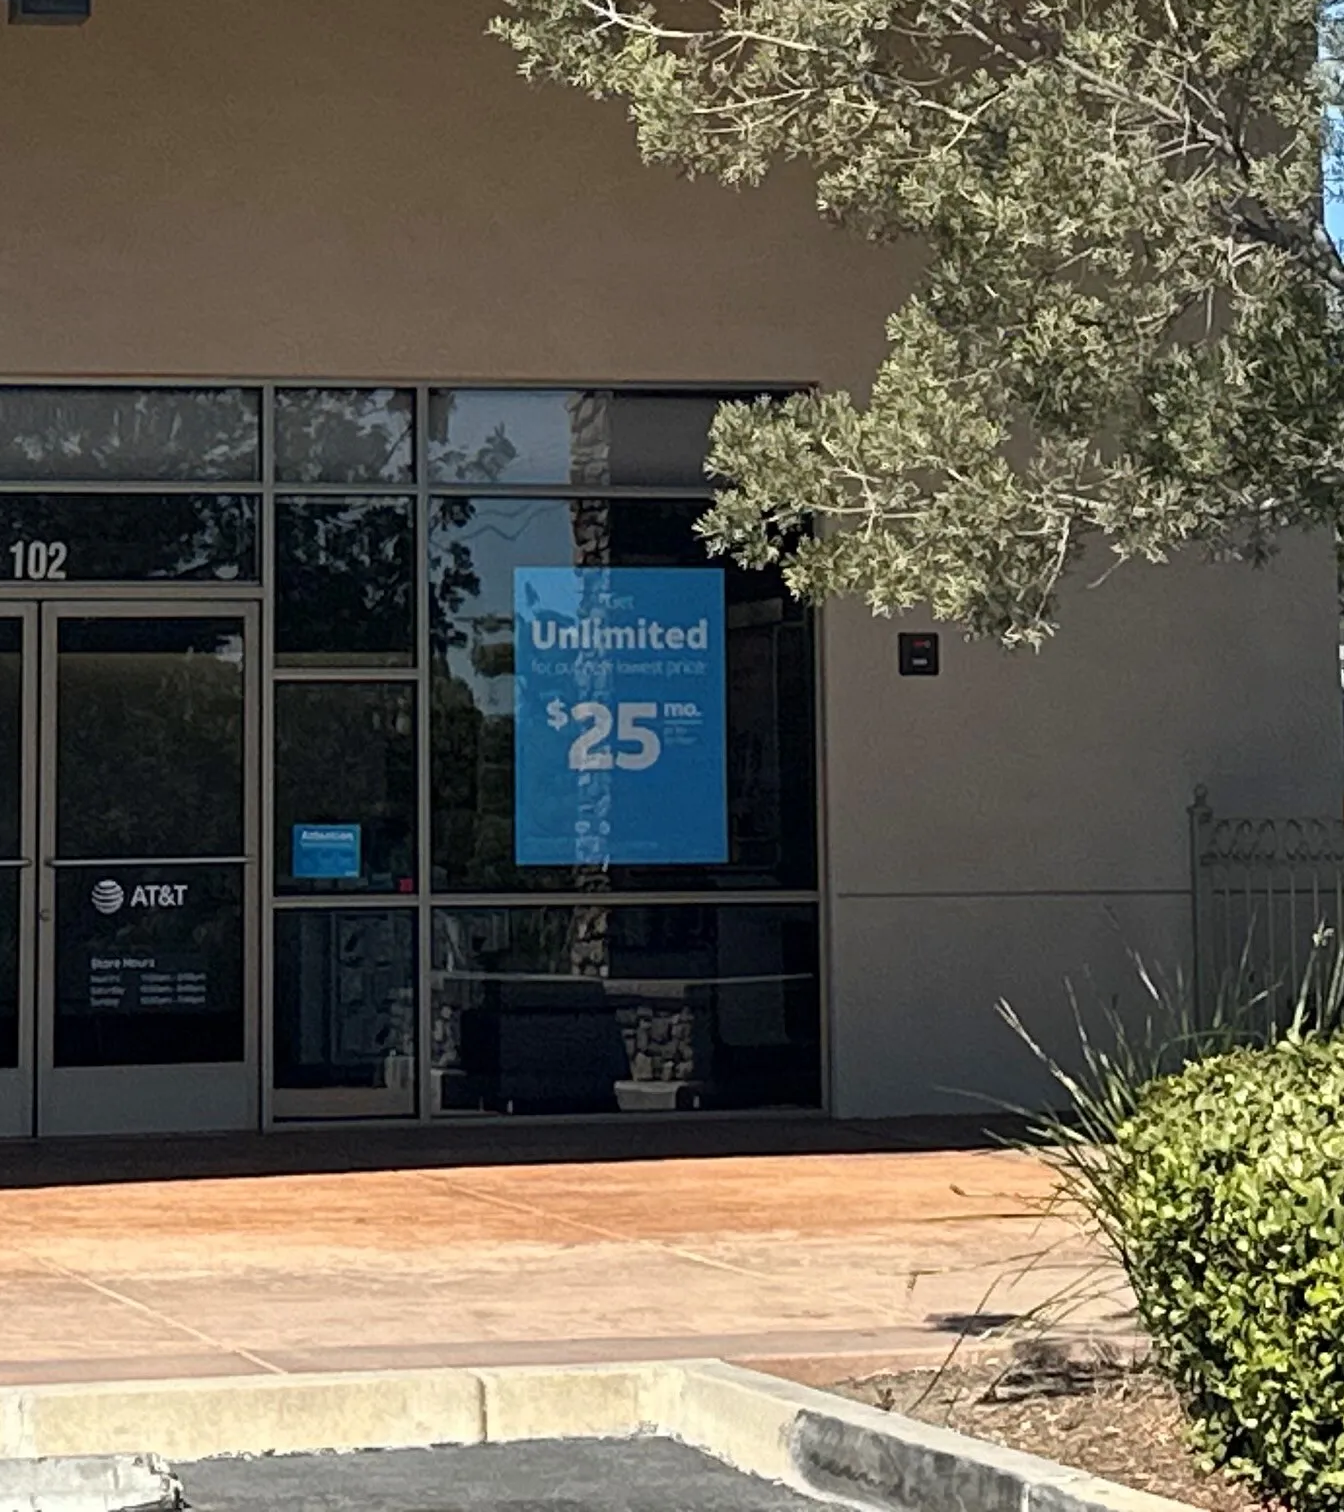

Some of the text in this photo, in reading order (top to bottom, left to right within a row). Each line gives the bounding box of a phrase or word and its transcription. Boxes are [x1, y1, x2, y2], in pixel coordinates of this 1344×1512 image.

[9, 540, 67, 580] 102
[532, 618, 708, 650] Unlimited
[546, 698, 661, 770] $25
[663, 702, 703, 717] mo.
[130, 884, 188, 907] AT&T
